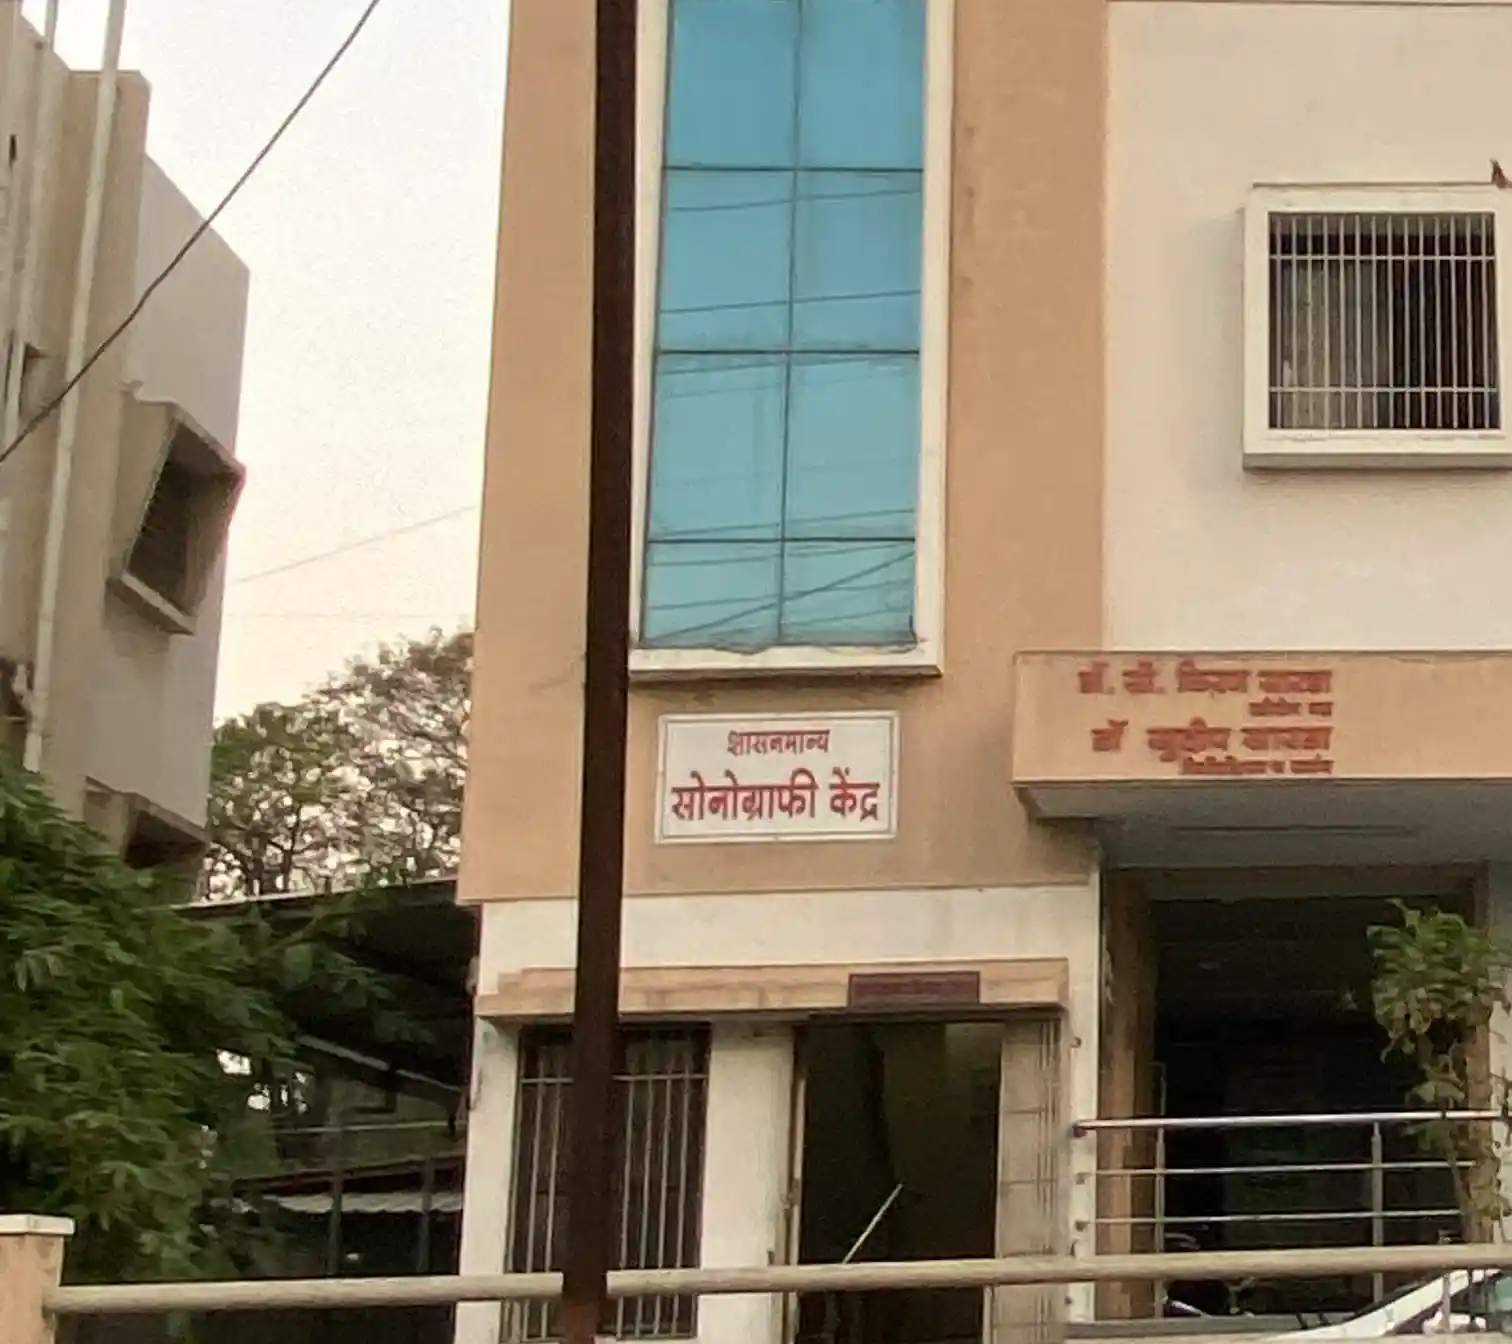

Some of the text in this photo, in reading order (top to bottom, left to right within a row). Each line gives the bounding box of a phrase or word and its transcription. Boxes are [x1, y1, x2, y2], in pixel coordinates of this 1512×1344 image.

[726, 729, 830, 756] शासनमान्य
[671, 766, 881, 822] सोनोग्राफी केंद्र
